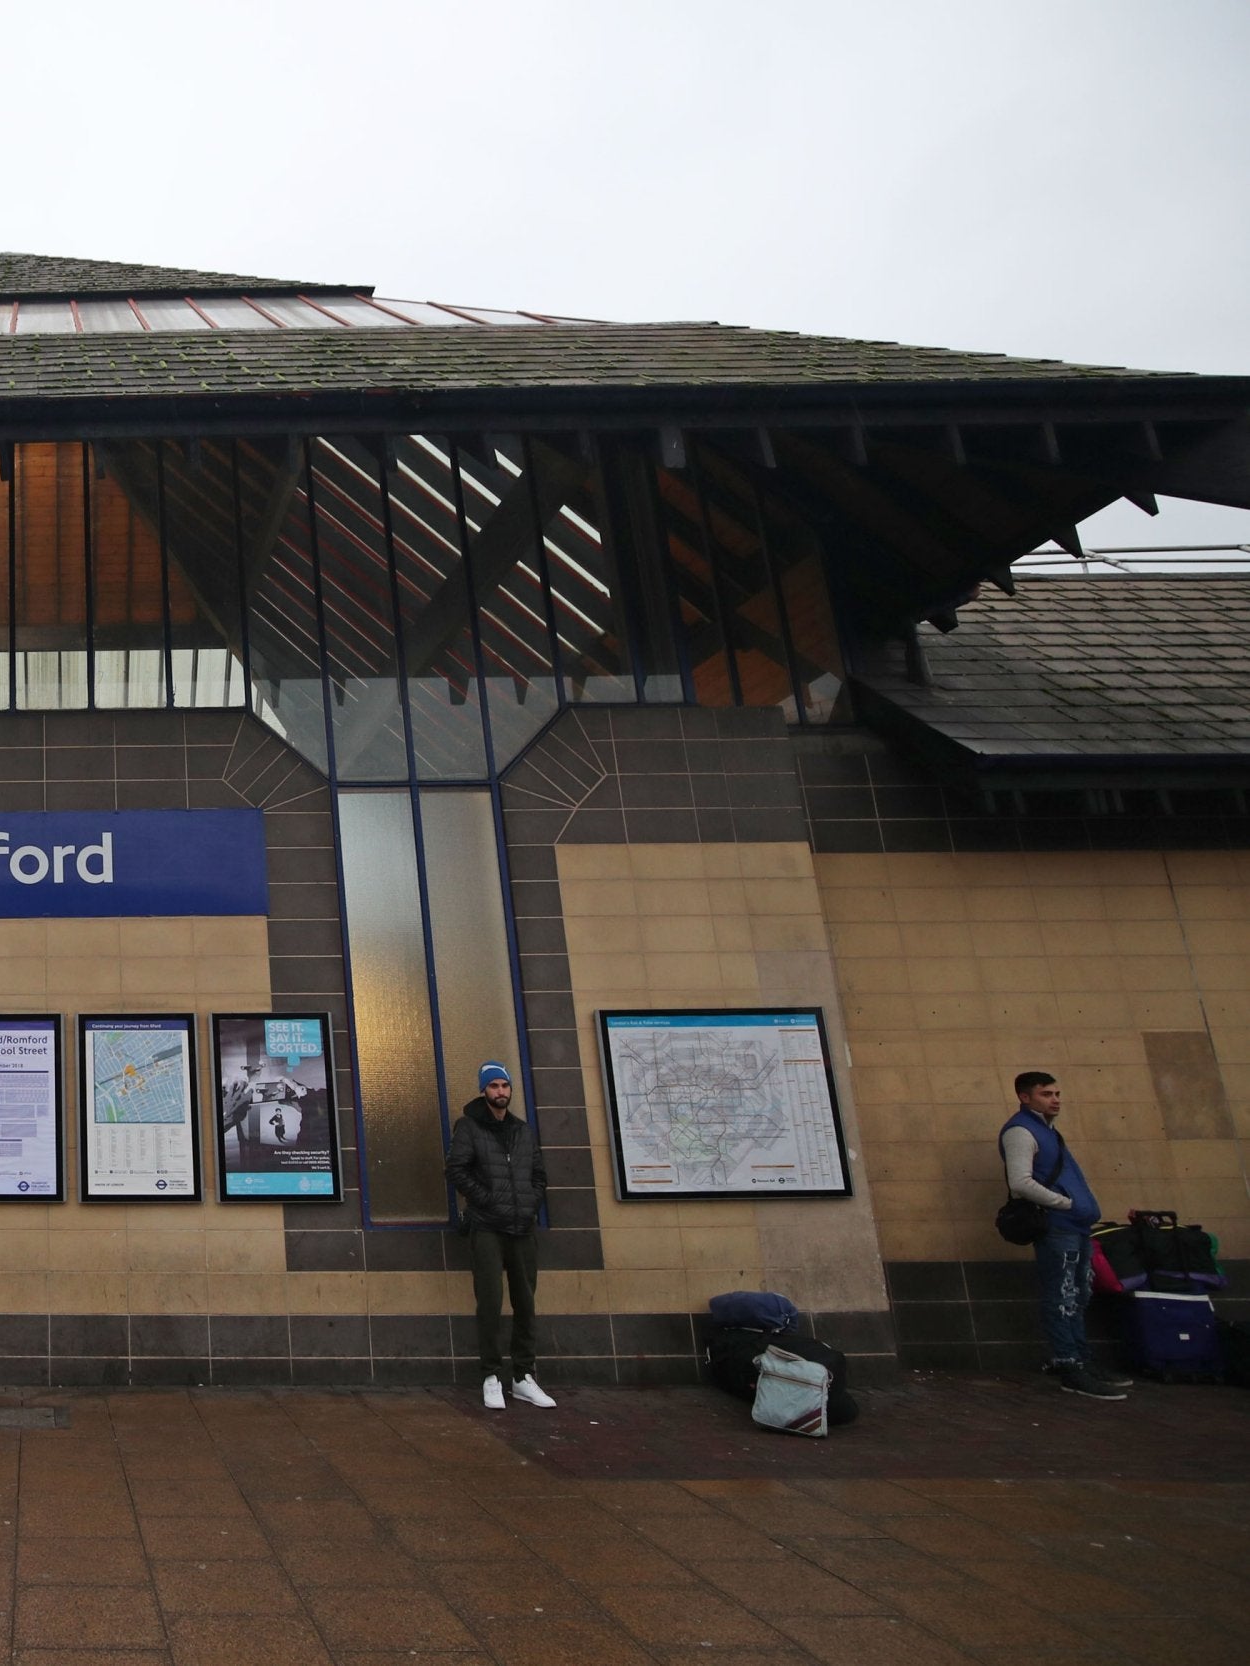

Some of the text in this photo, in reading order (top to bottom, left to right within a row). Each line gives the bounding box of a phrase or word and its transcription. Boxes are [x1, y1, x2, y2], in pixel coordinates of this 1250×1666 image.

[269, 1022, 305, 1032] SEE IT.
[269, 1033, 305, 1042] SAY IT.
[270, 1043, 320, 1053] SORTED.
